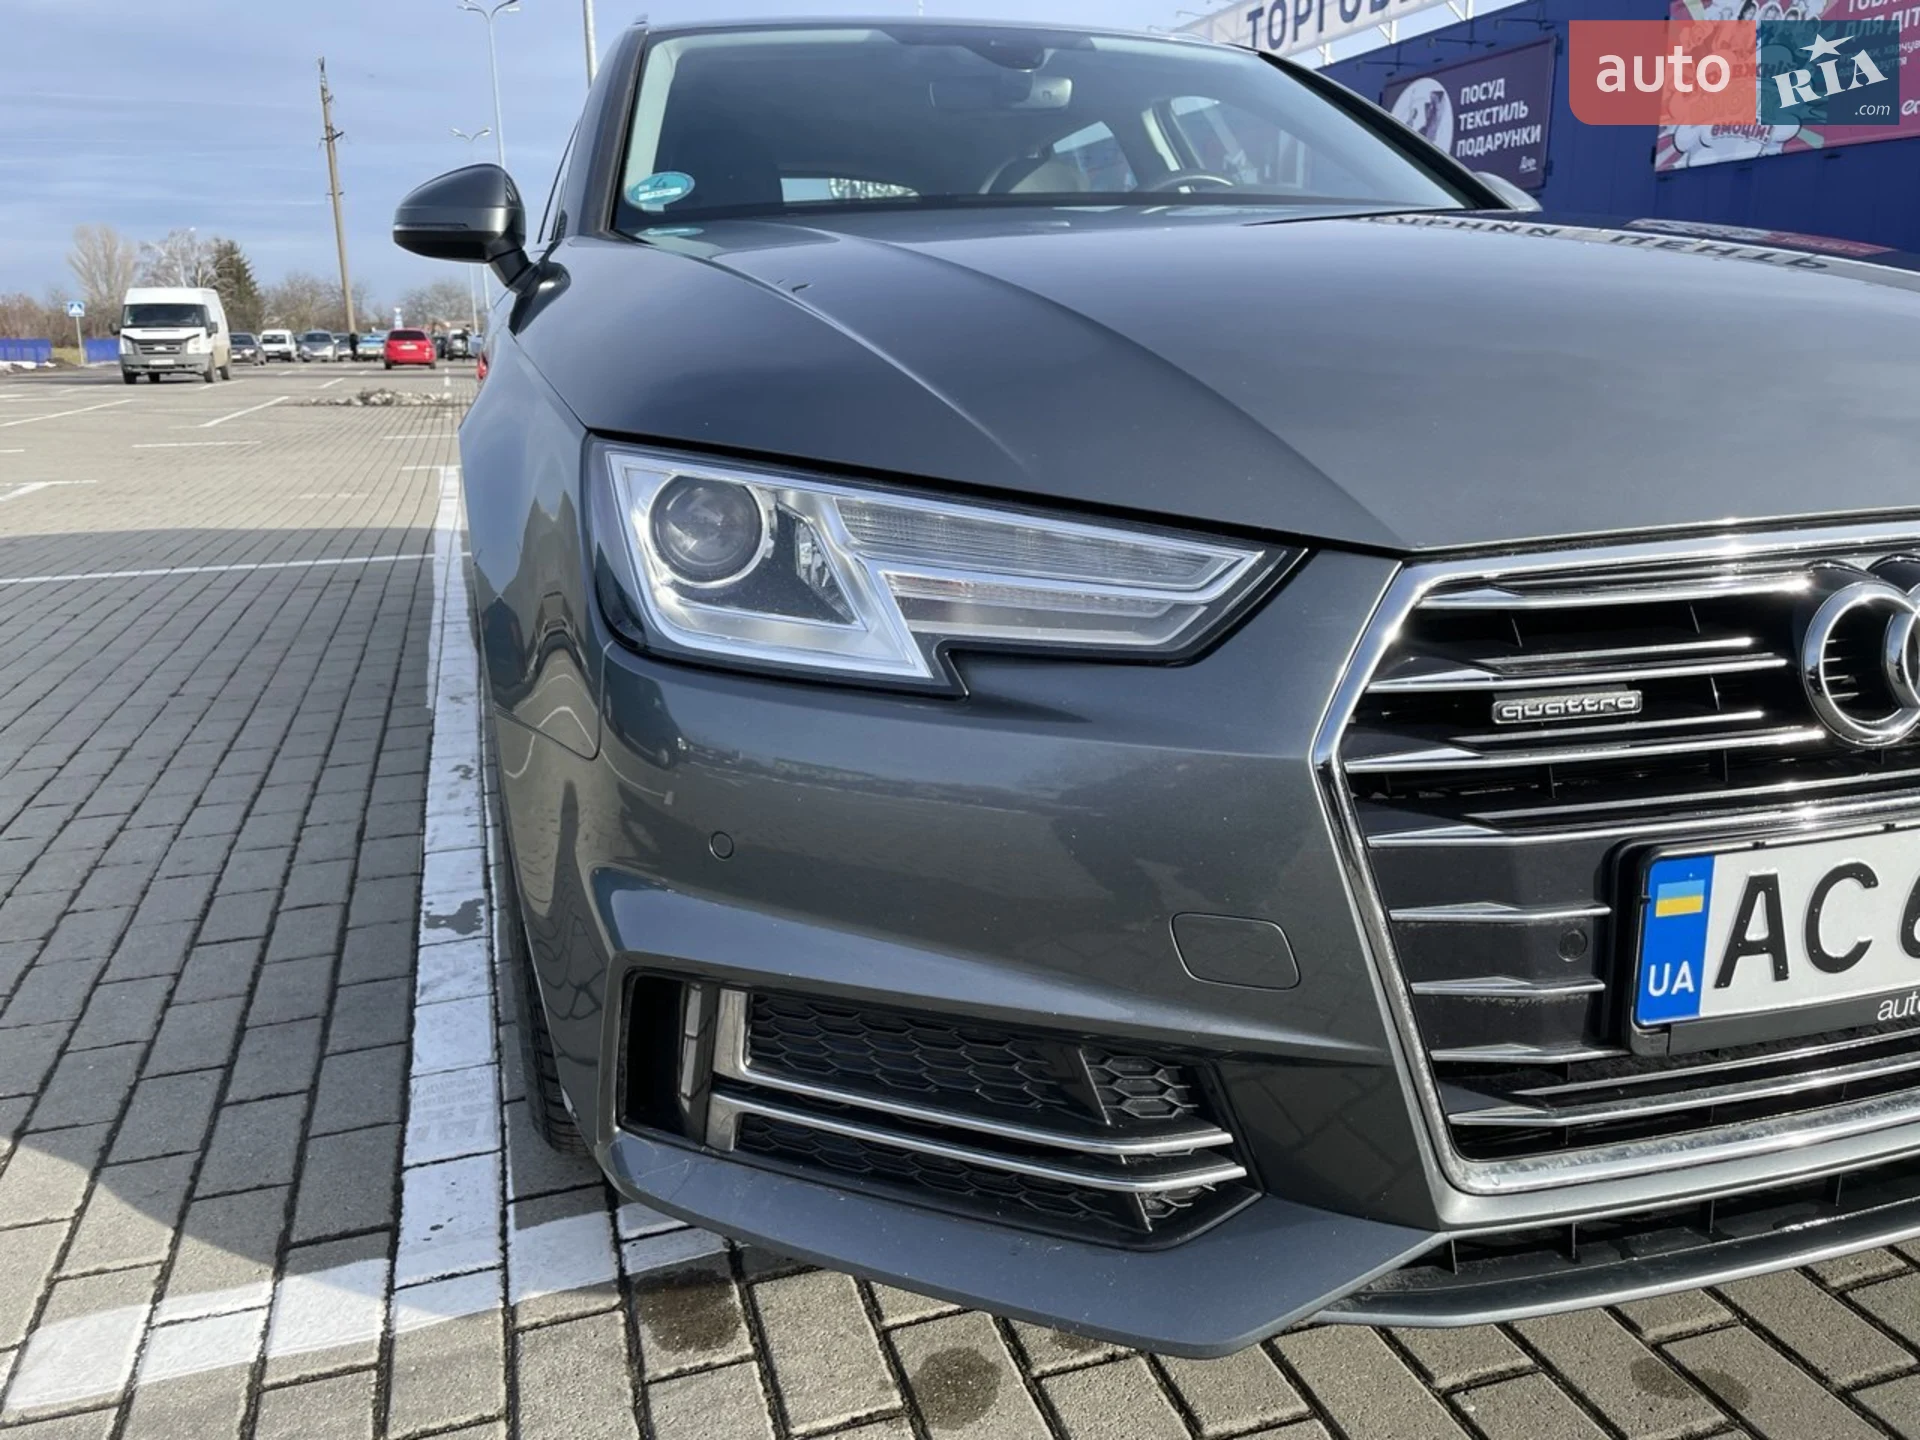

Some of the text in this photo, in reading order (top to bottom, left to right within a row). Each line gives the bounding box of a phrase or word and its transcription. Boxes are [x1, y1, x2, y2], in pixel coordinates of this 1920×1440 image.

[1460, 78, 1506, 105] ПОСУД
[1458, 100, 1529, 132] ТЕКСТИЛЬ
[1456, 124, 1541, 158] ПОДАРУНКИ
[1501, 696, 1636, 721] quattro
[1713, 861, 1879, 989] AC
[1648, 960, 1694, 997] UA
[1877, 990, 1920, 1021] aut
